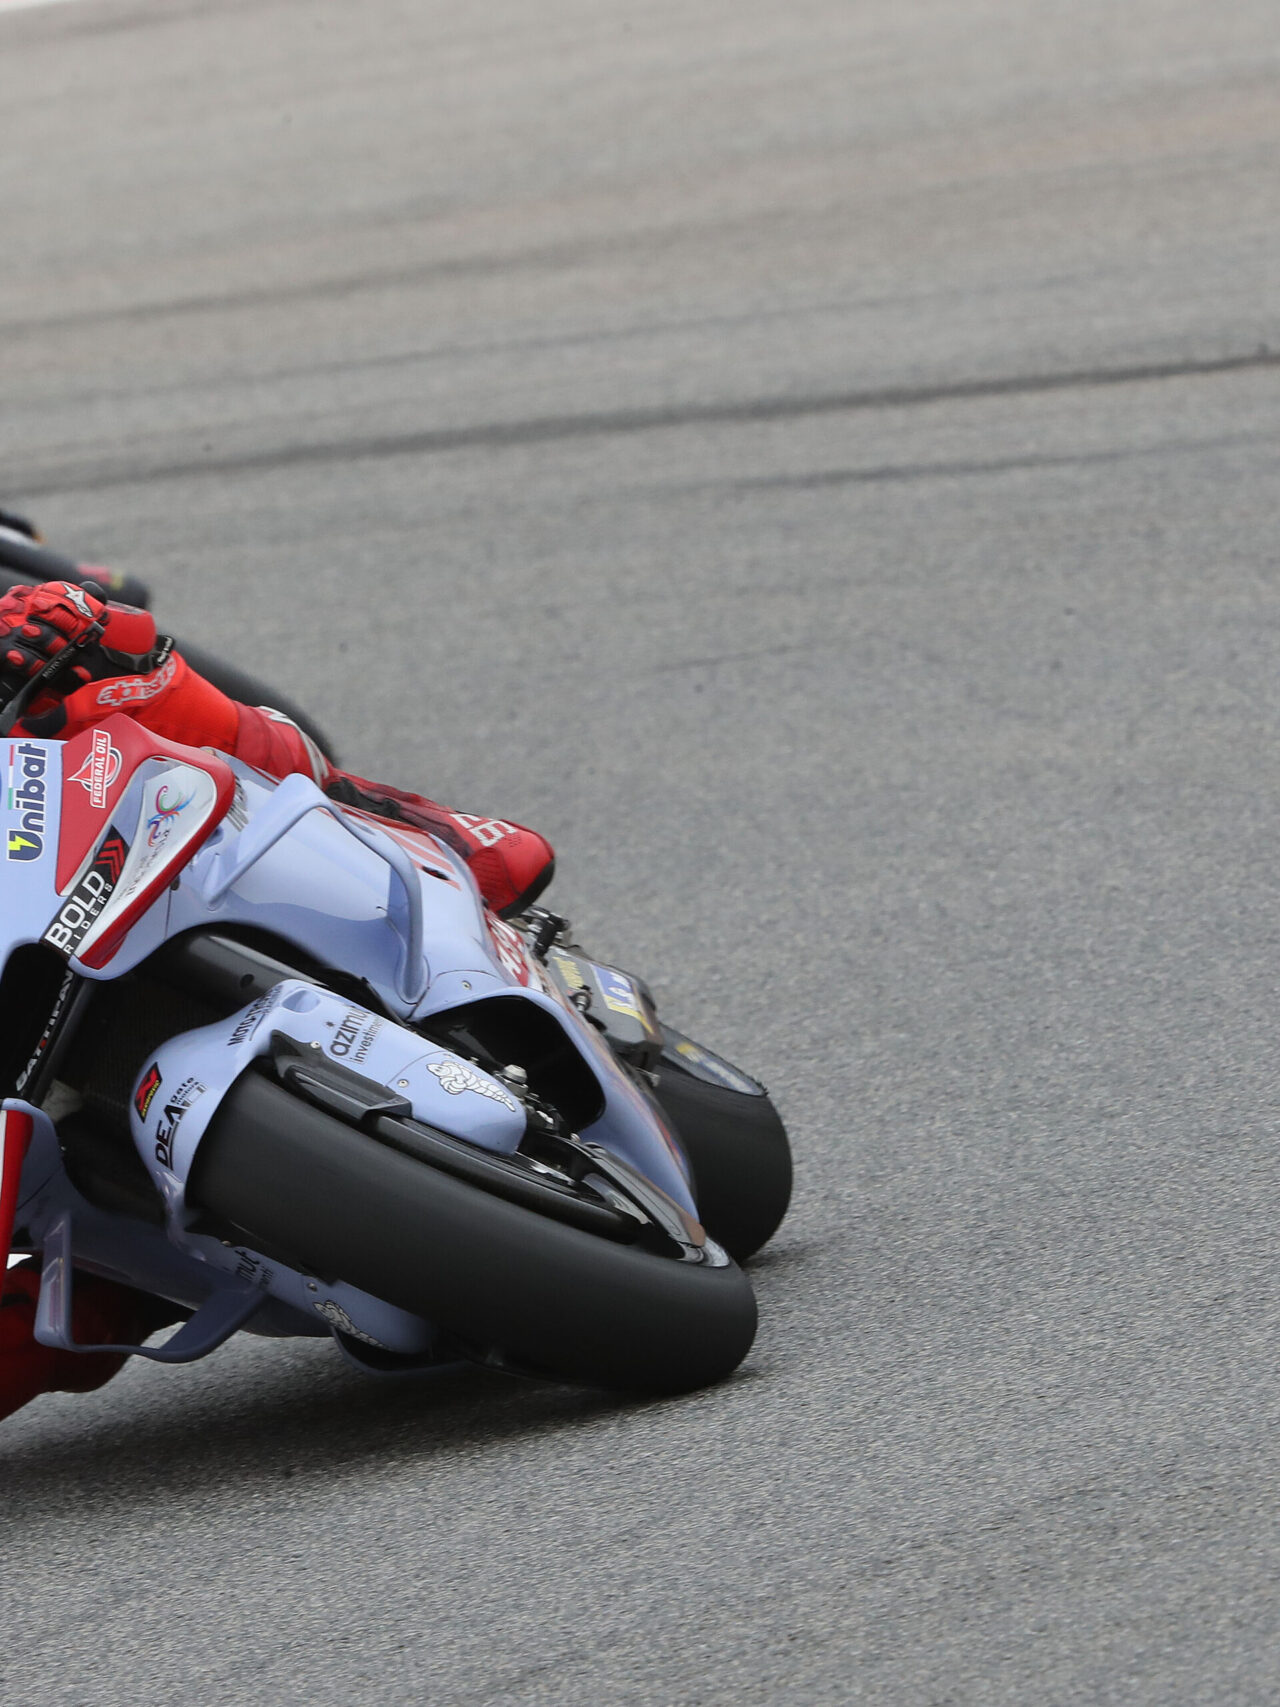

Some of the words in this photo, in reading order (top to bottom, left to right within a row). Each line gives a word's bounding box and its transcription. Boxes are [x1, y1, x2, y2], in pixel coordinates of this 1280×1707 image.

[96, 735, 108, 758] OIL
[8, 742, 47, 861] Unibat
[93, 760, 108, 805] FEDERAL
[44, 870, 106, 948] BOLD
[63, 882, 114, 955] RIDERS
[171, 1077, 195, 1103] gate
[155, 1105, 187, 1168] DEA
